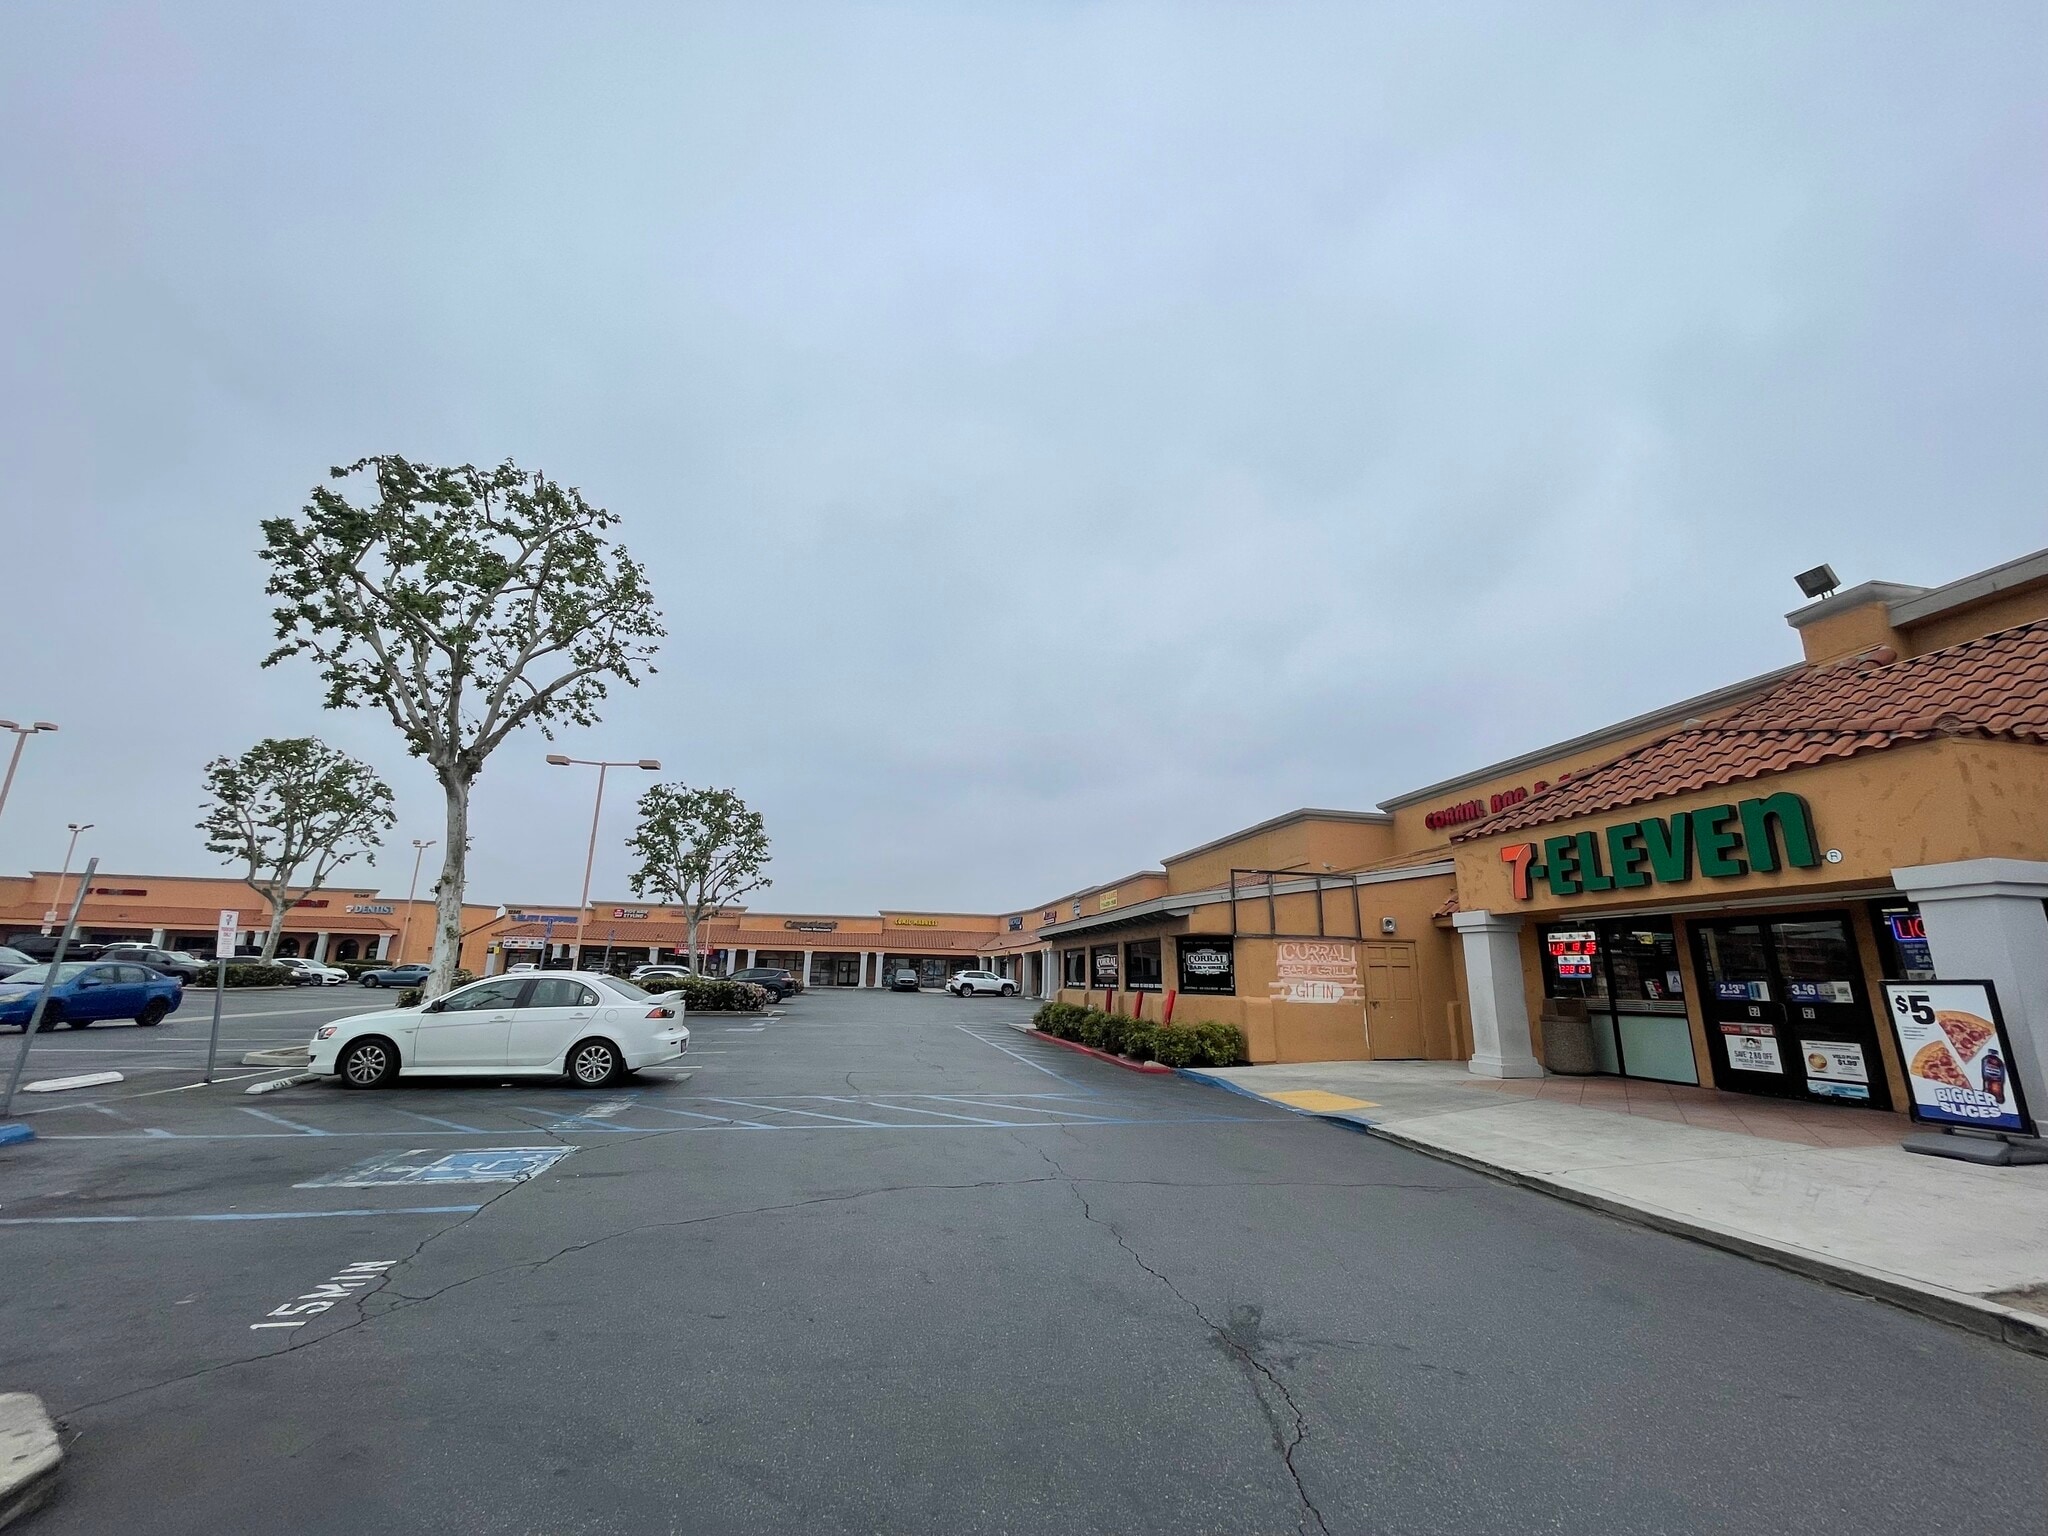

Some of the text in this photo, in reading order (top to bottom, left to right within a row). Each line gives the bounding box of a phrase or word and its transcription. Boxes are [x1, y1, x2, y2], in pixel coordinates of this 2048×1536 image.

[354, 904, 395, 914] DENTIST
[1896, 918, 1926, 937] LIQ
[1188, 955, 1227, 963] CORRAL
[1282, 943, 1350, 962] CORRAL
[1296, 983, 1334, 999] GIT IN
[1895, 995, 1936, 1025] $5
[1934, 1087, 1998, 1107] BIGGER
[1938, 1101, 2002, 1118] SLICES
